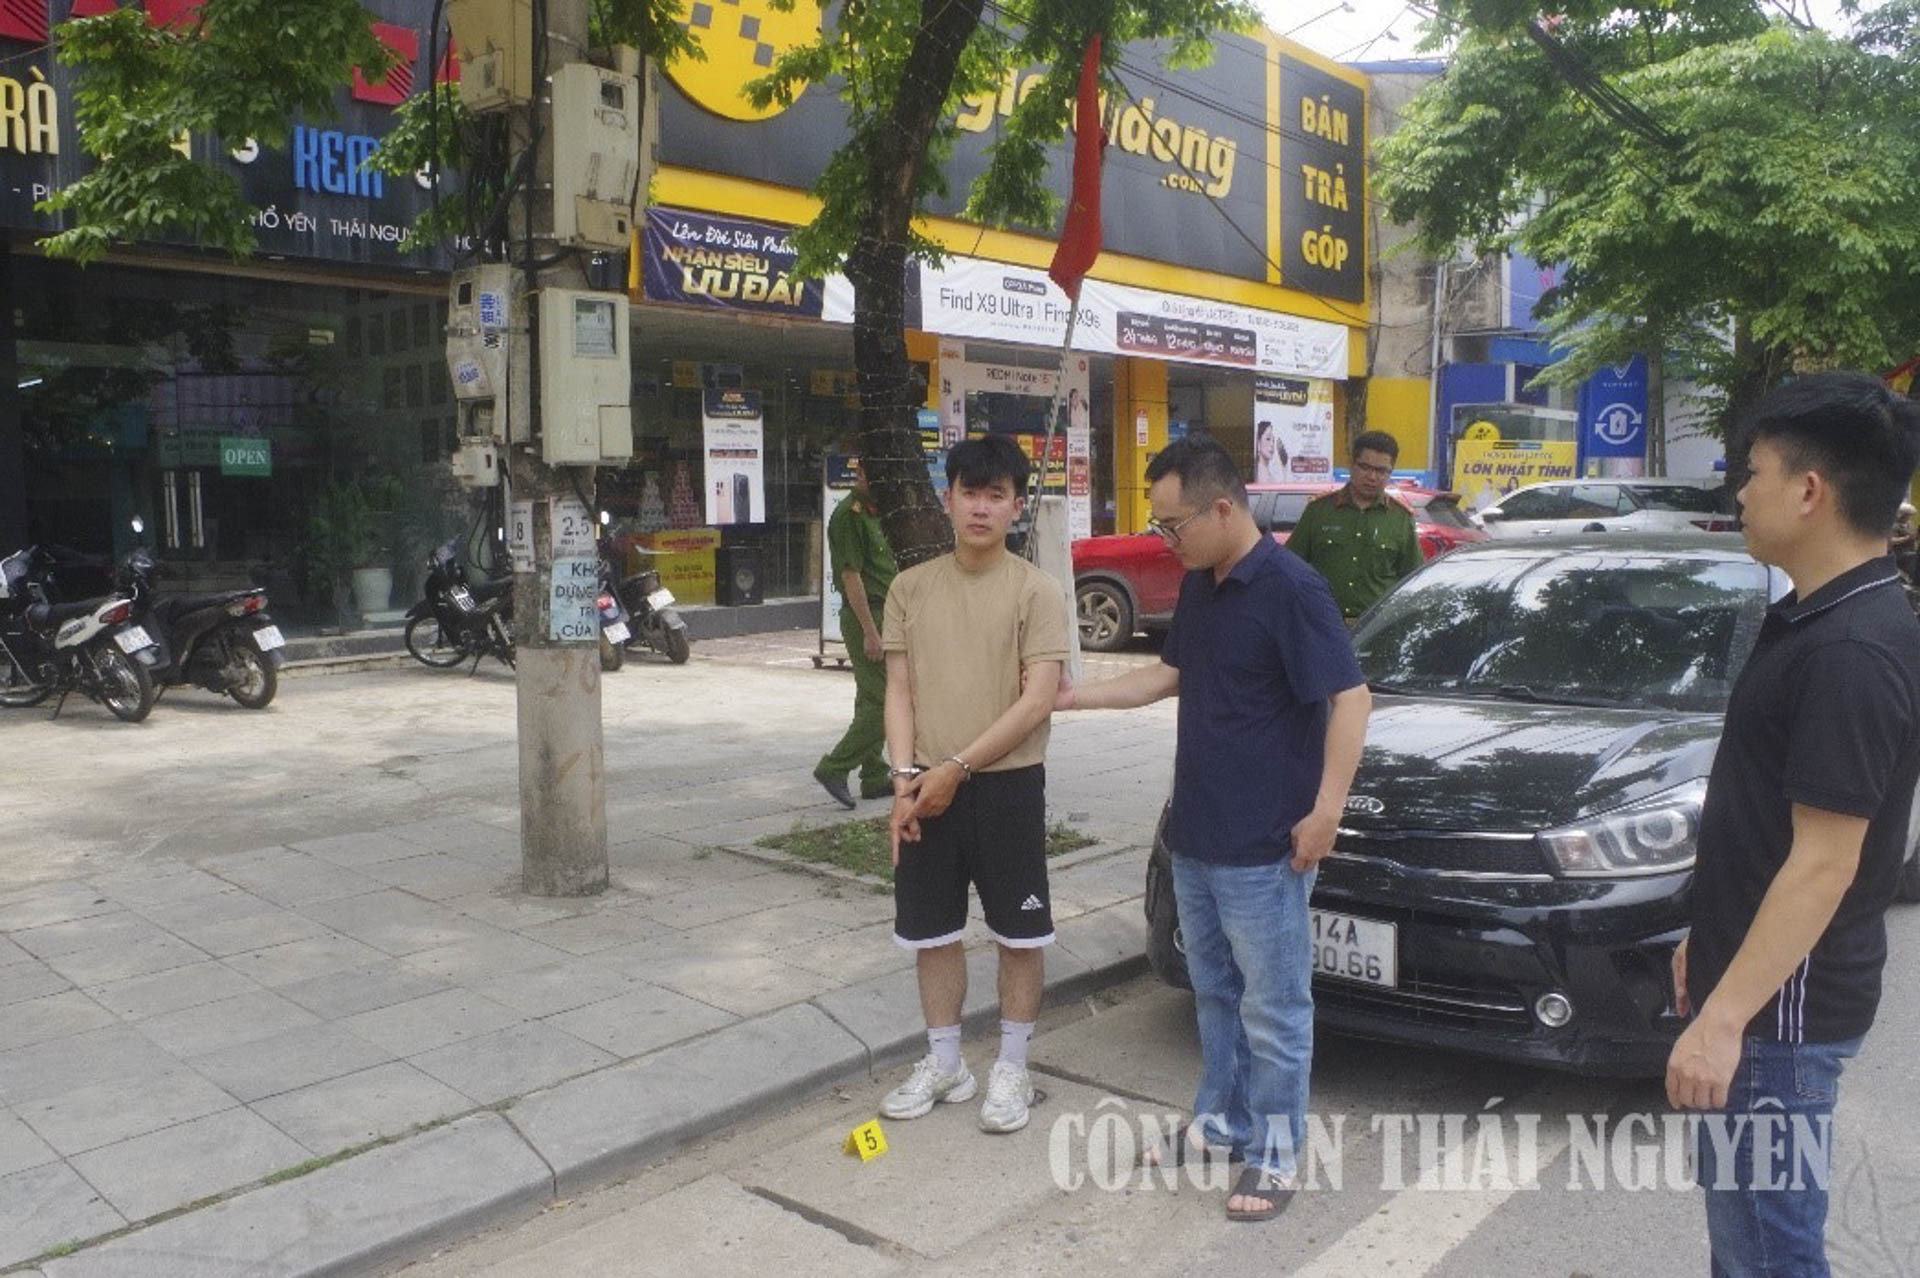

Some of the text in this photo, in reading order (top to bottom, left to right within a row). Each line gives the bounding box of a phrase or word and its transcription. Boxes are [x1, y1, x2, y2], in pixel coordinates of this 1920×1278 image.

[1301, 95, 1348, 145] BÁN
[293, 125, 383, 198] KEM
[1301, 163, 1348, 211] TRẢ
[243, 205, 280, 229] HỔ
[284, 213, 316, 232] YÊN
[330, 218, 366, 239] THÁI
[724, 251, 770, 275] SIÊU
[1302, 225, 1348, 271] GÓP
[682, 266, 804, 308] ƯU ĐÃI
[940, 287, 973, 311] Find
[976, 292, 997, 315] X9
[1000, 295, 1034, 319] Ultra
[225, 450, 267, 465] OPEN
[1312, 914, 1359, 947] 14A
[863, 1129, 878, 1151] 5
